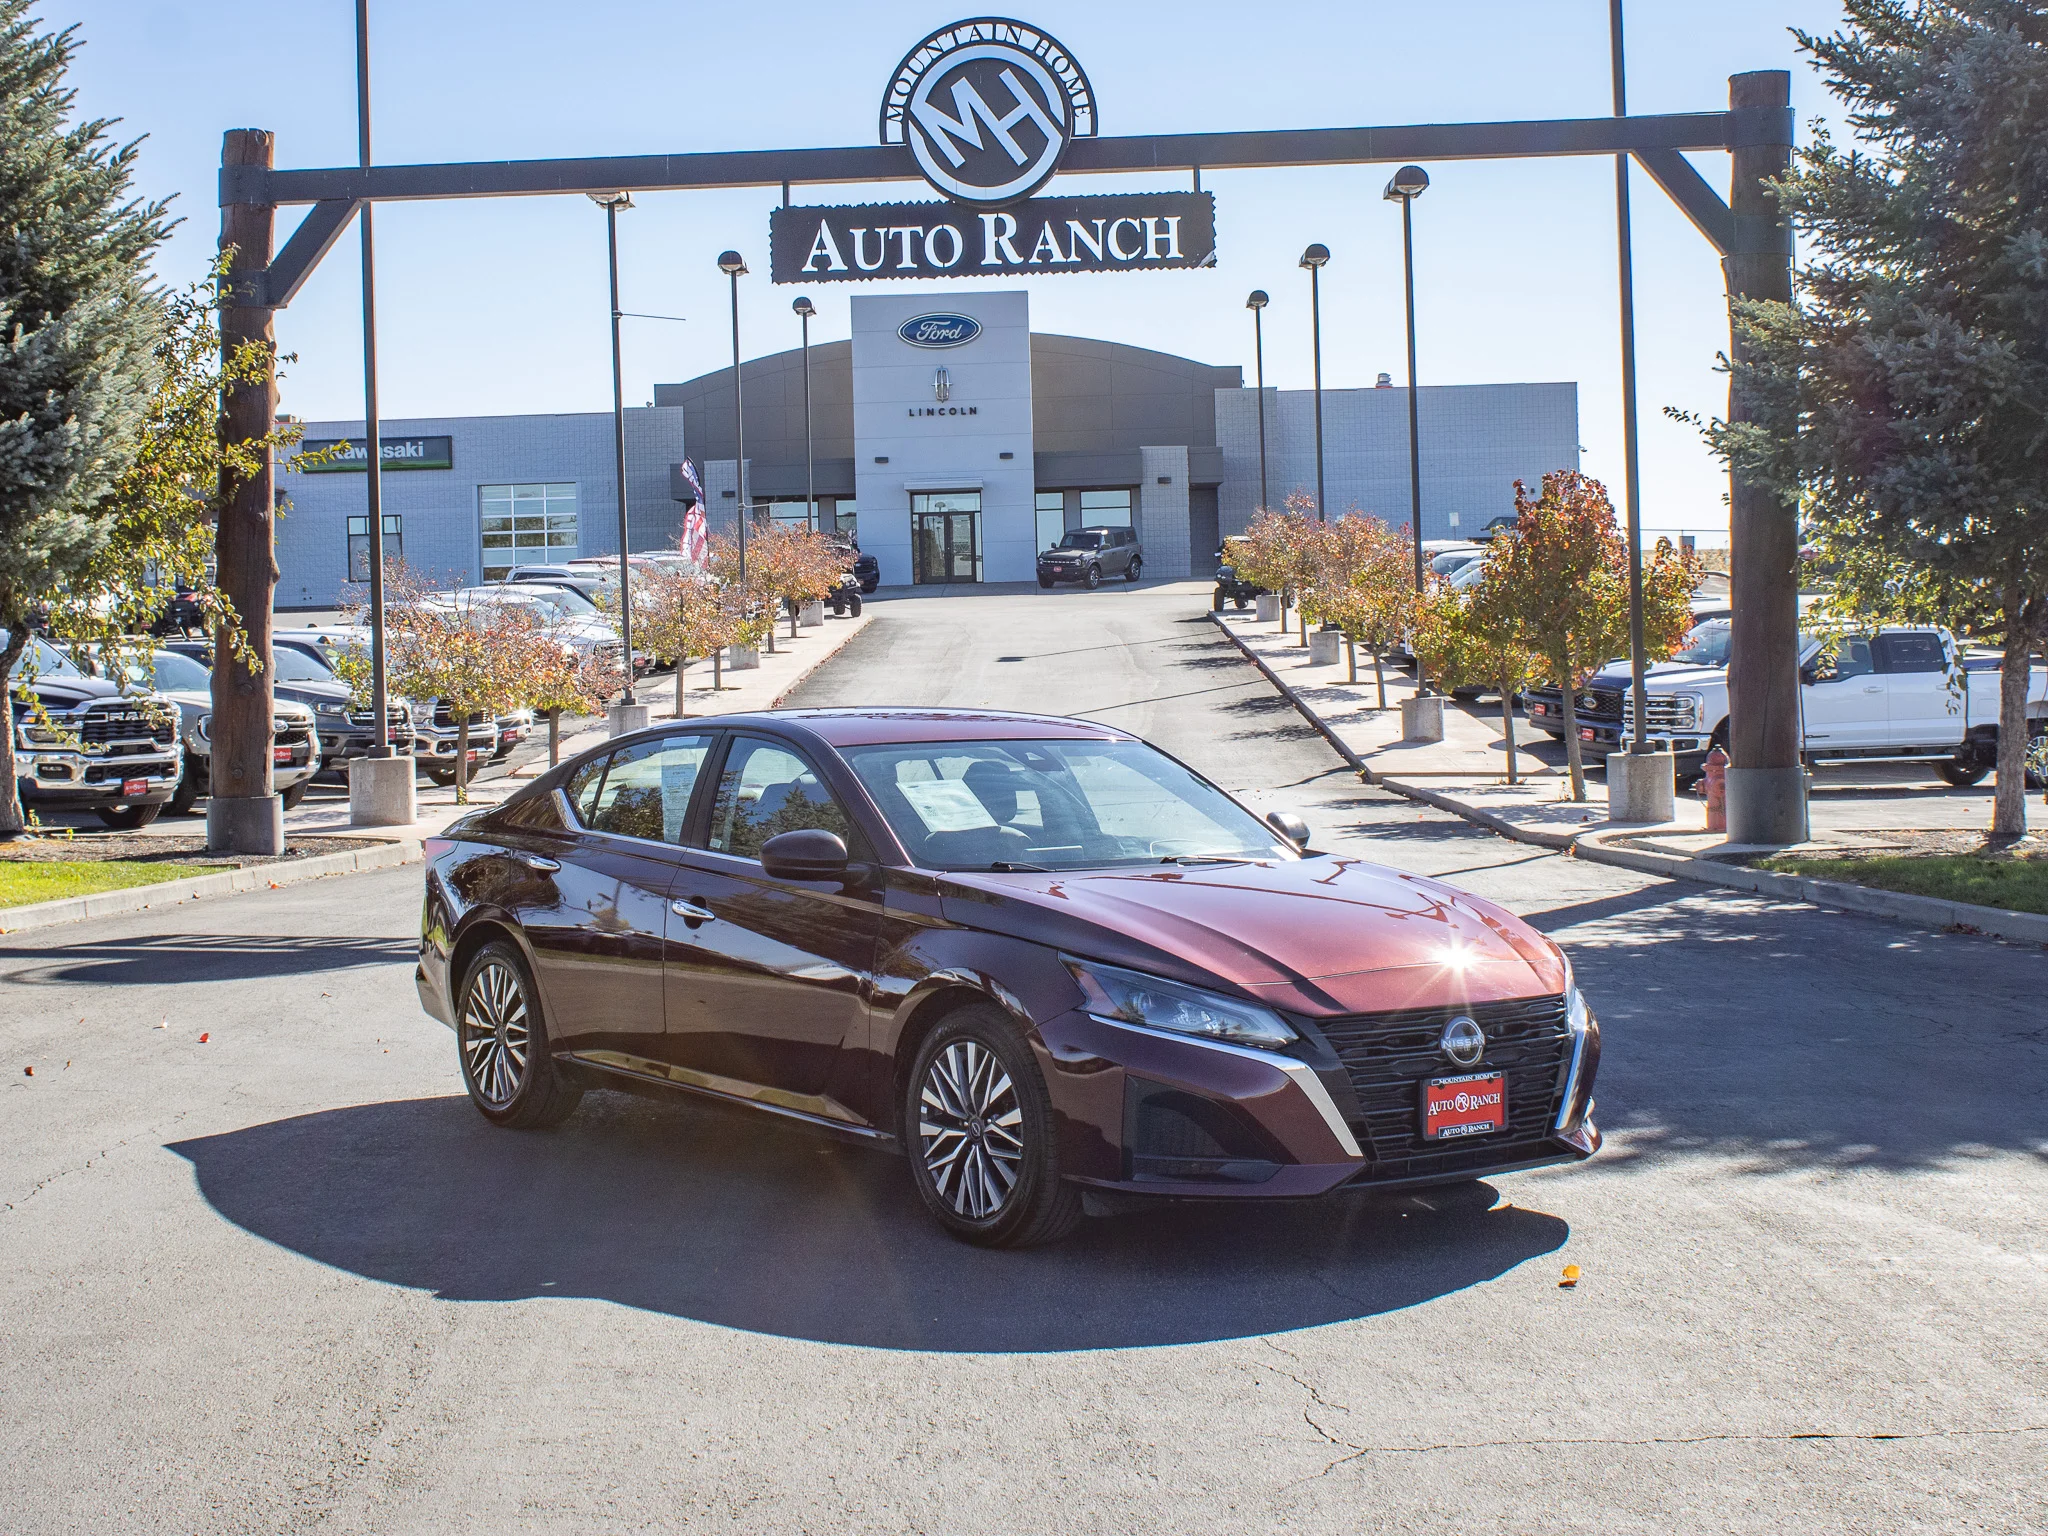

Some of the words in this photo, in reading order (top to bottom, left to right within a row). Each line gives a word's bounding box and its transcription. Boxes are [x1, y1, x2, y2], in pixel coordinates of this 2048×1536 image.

[885, 23, 1023, 123] MOUNTAIN
[1033, 36, 1092, 118] HOME
[801, 218, 963, 273] AUTO
[978, 212, 1184, 266] RANCH
[916, 320, 963, 341] Ford
[908, 406, 978, 417] LINCOLN
[328, 441, 424, 459] Kawsaki
[1441, 1034, 1485, 1050] NISSAN
[1439, 1075, 1473, 1085] MOUNTAIN
[1427, 1099, 1455, 1116] AUTO
[1470, 1092, 1501, 1110] RANCH
[1442, 1127, 1460, 1137] AUTO
[1468, 1123, 1490, 1133] RANCH
